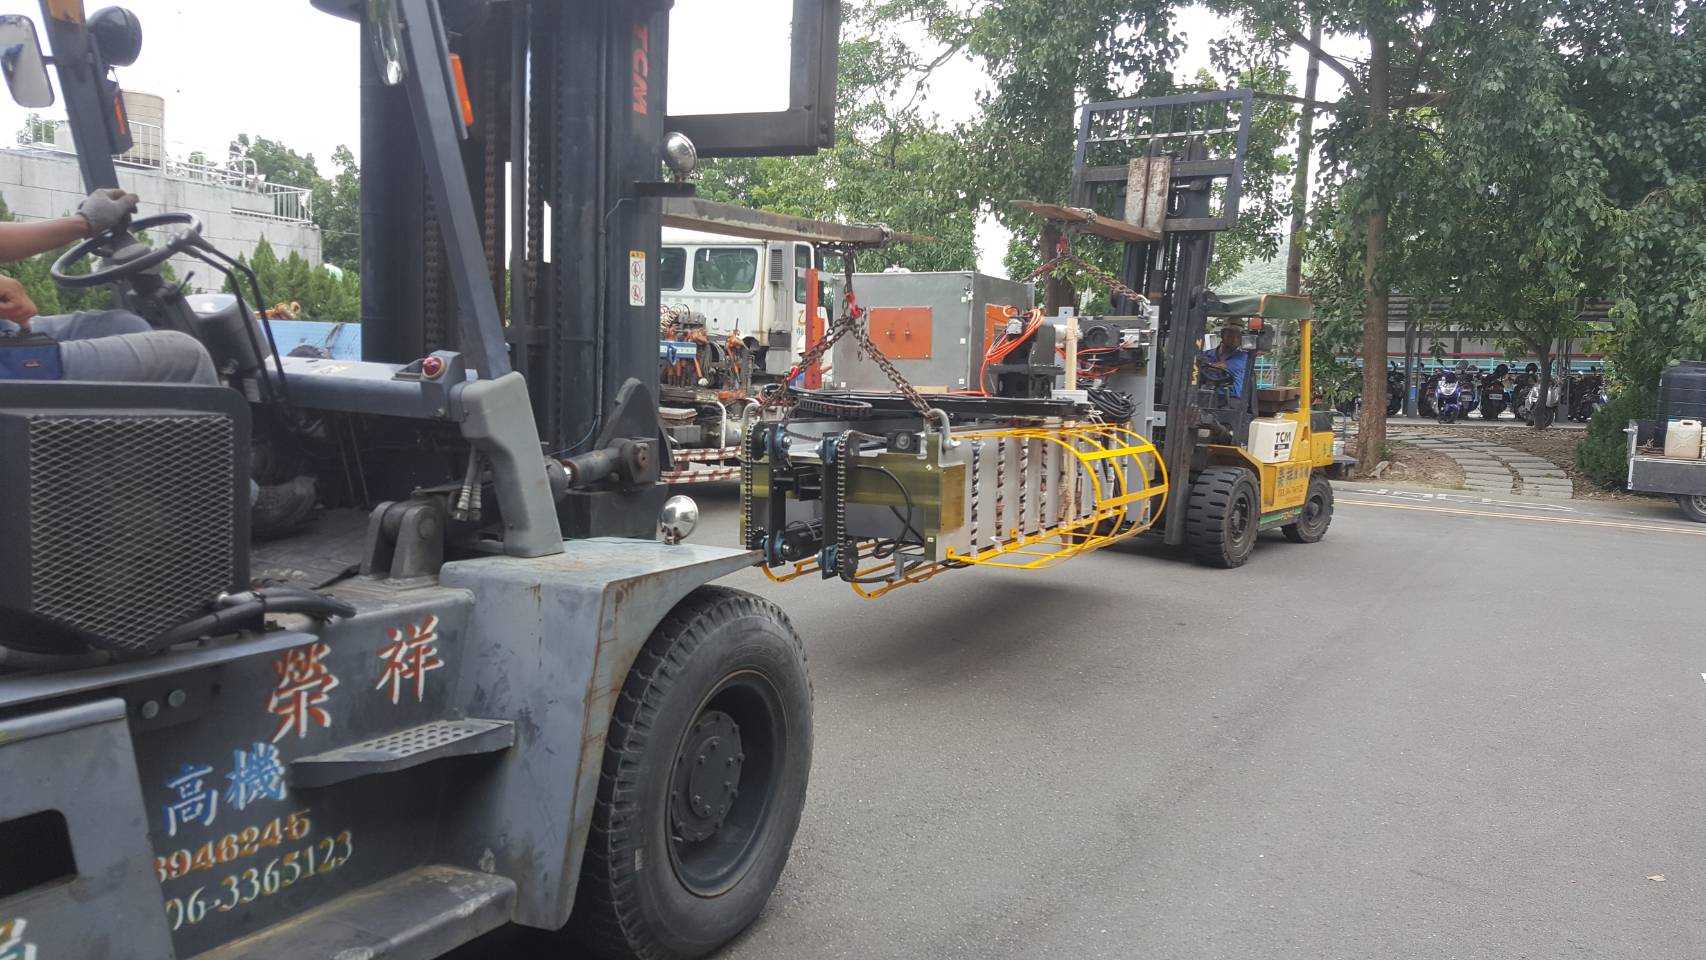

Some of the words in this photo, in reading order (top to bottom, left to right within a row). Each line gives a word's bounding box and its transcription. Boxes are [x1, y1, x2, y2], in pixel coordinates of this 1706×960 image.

[1275, 431, 1292, 444] TCM
[266, 614, 445, 743] 榮祥
[162, 742, 288, 836] 高機
